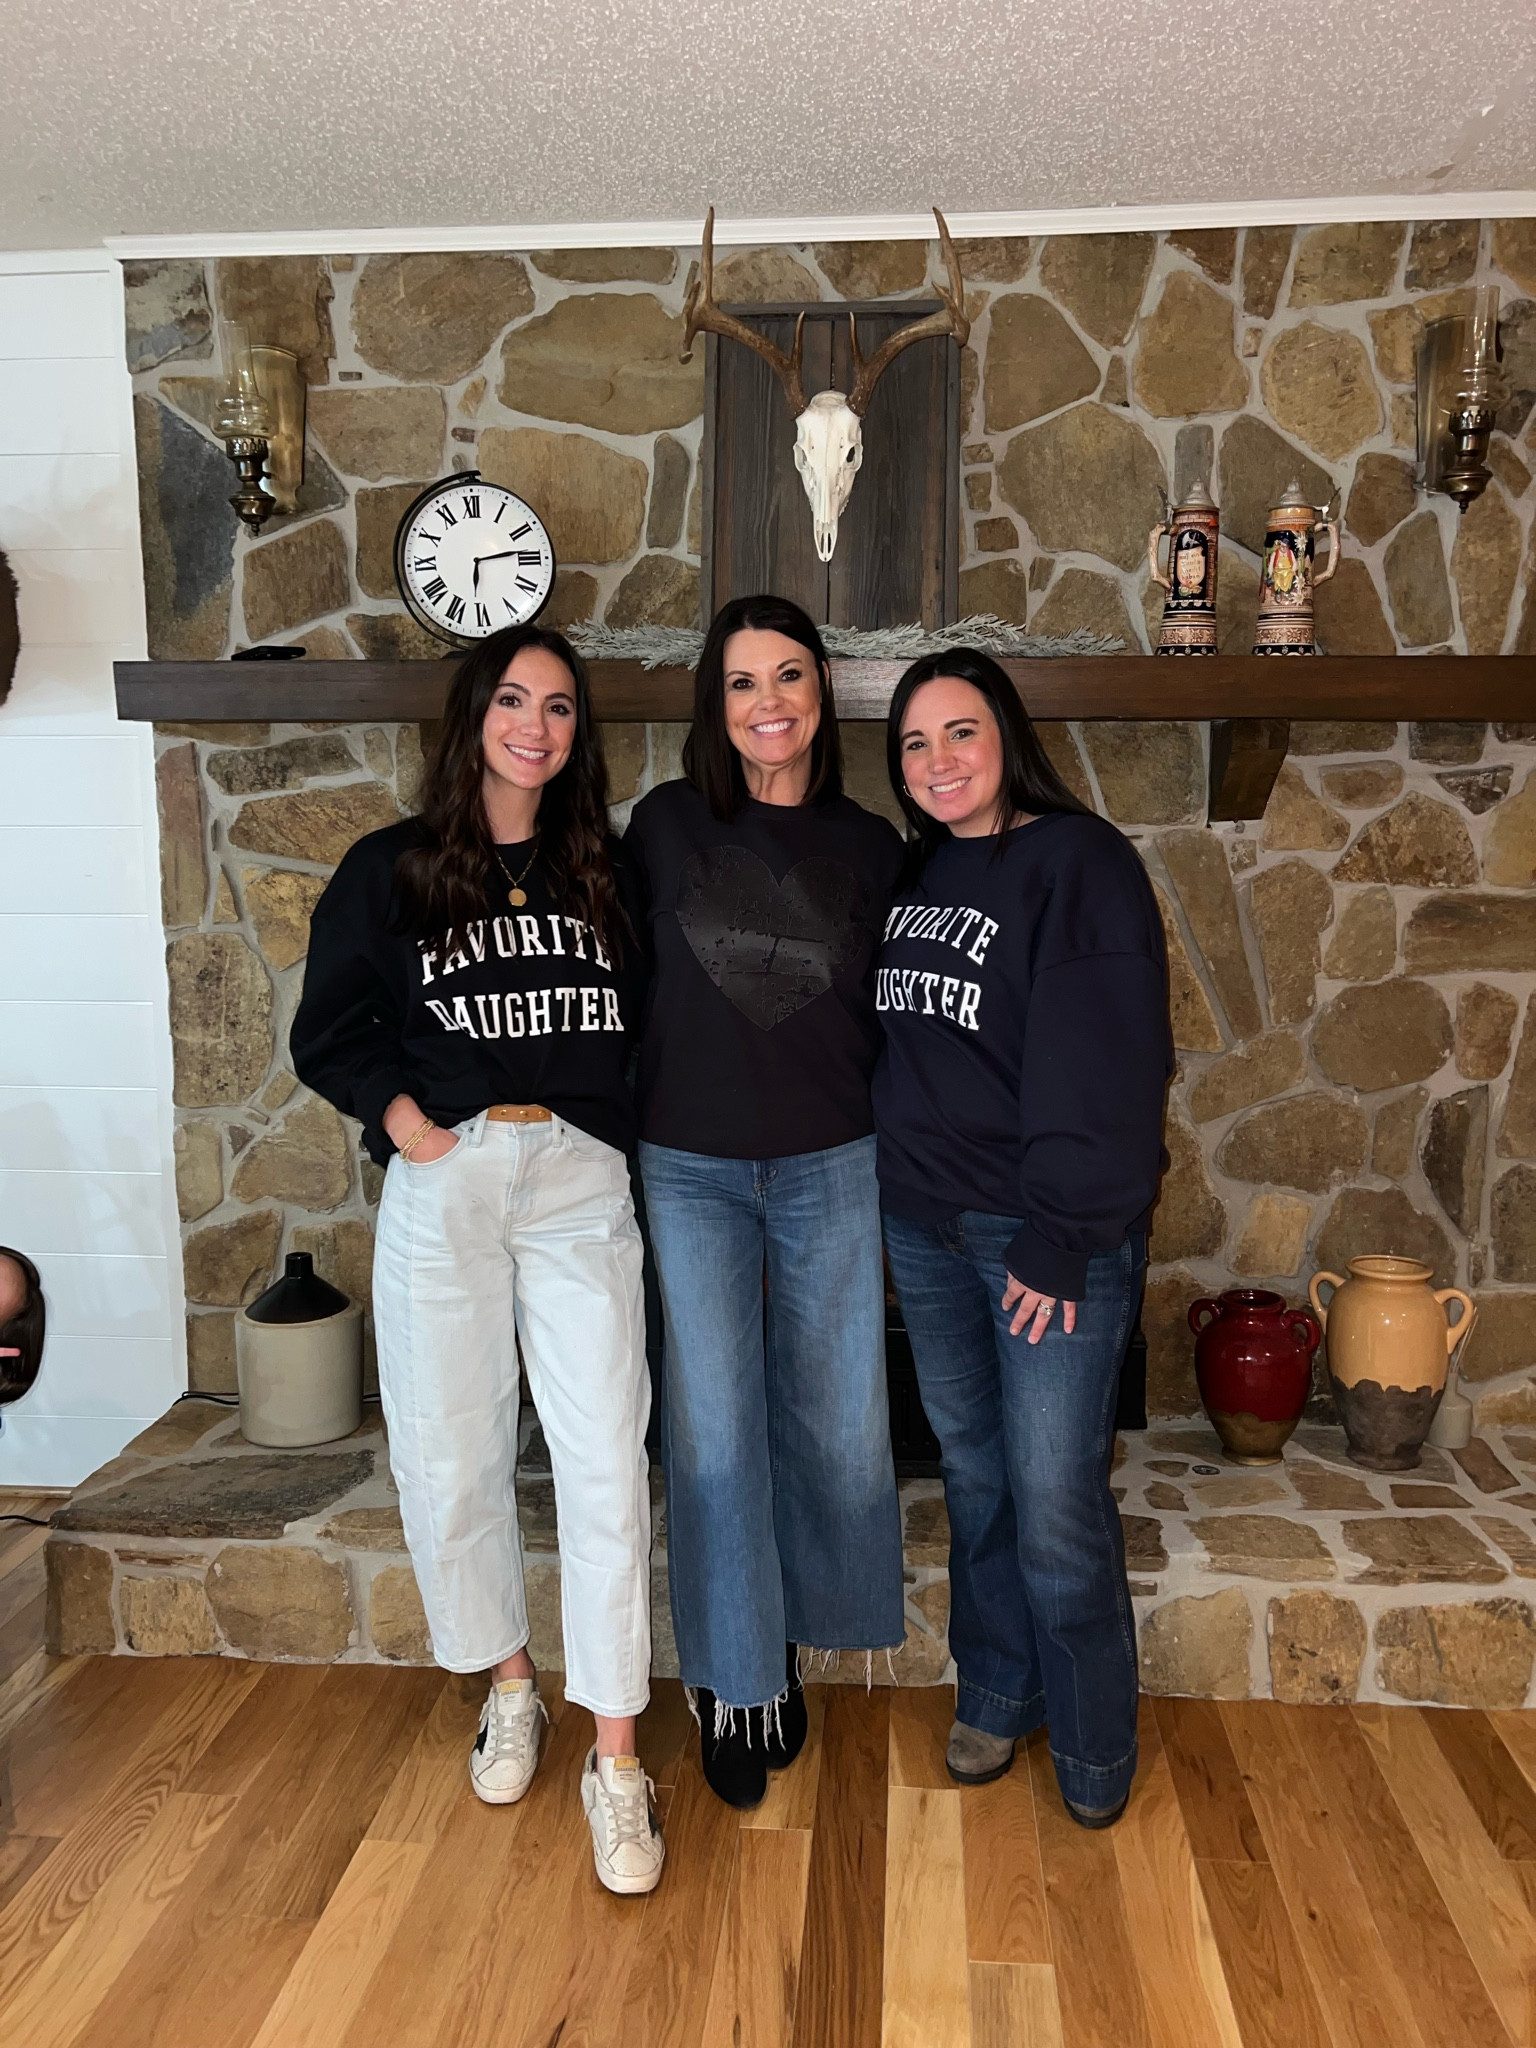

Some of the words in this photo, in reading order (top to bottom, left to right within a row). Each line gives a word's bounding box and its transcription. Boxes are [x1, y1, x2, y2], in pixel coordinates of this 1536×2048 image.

[435, 503, 459, 530] XI
[462, 495, 482, 519] XII
[494, 501, 508, 524] I
[418, 527, 442, 548] X
[508, 521, 533, 542] II
[413, 555, 437, 573] IX
[517, 549, 542, 567] III
[421, 575, 449, 607] VIII
[514, 574, 538, 598] IV
[445, 594, 467, 625] VII
[474, 602, 491, 627] VI
[502, 597, 519, 618] V
[880, 905, 999, 966] AVORITE
[875, 968, 982, 1030] UGHTER
[424, 987, 625, 1039] DAUGHTER
